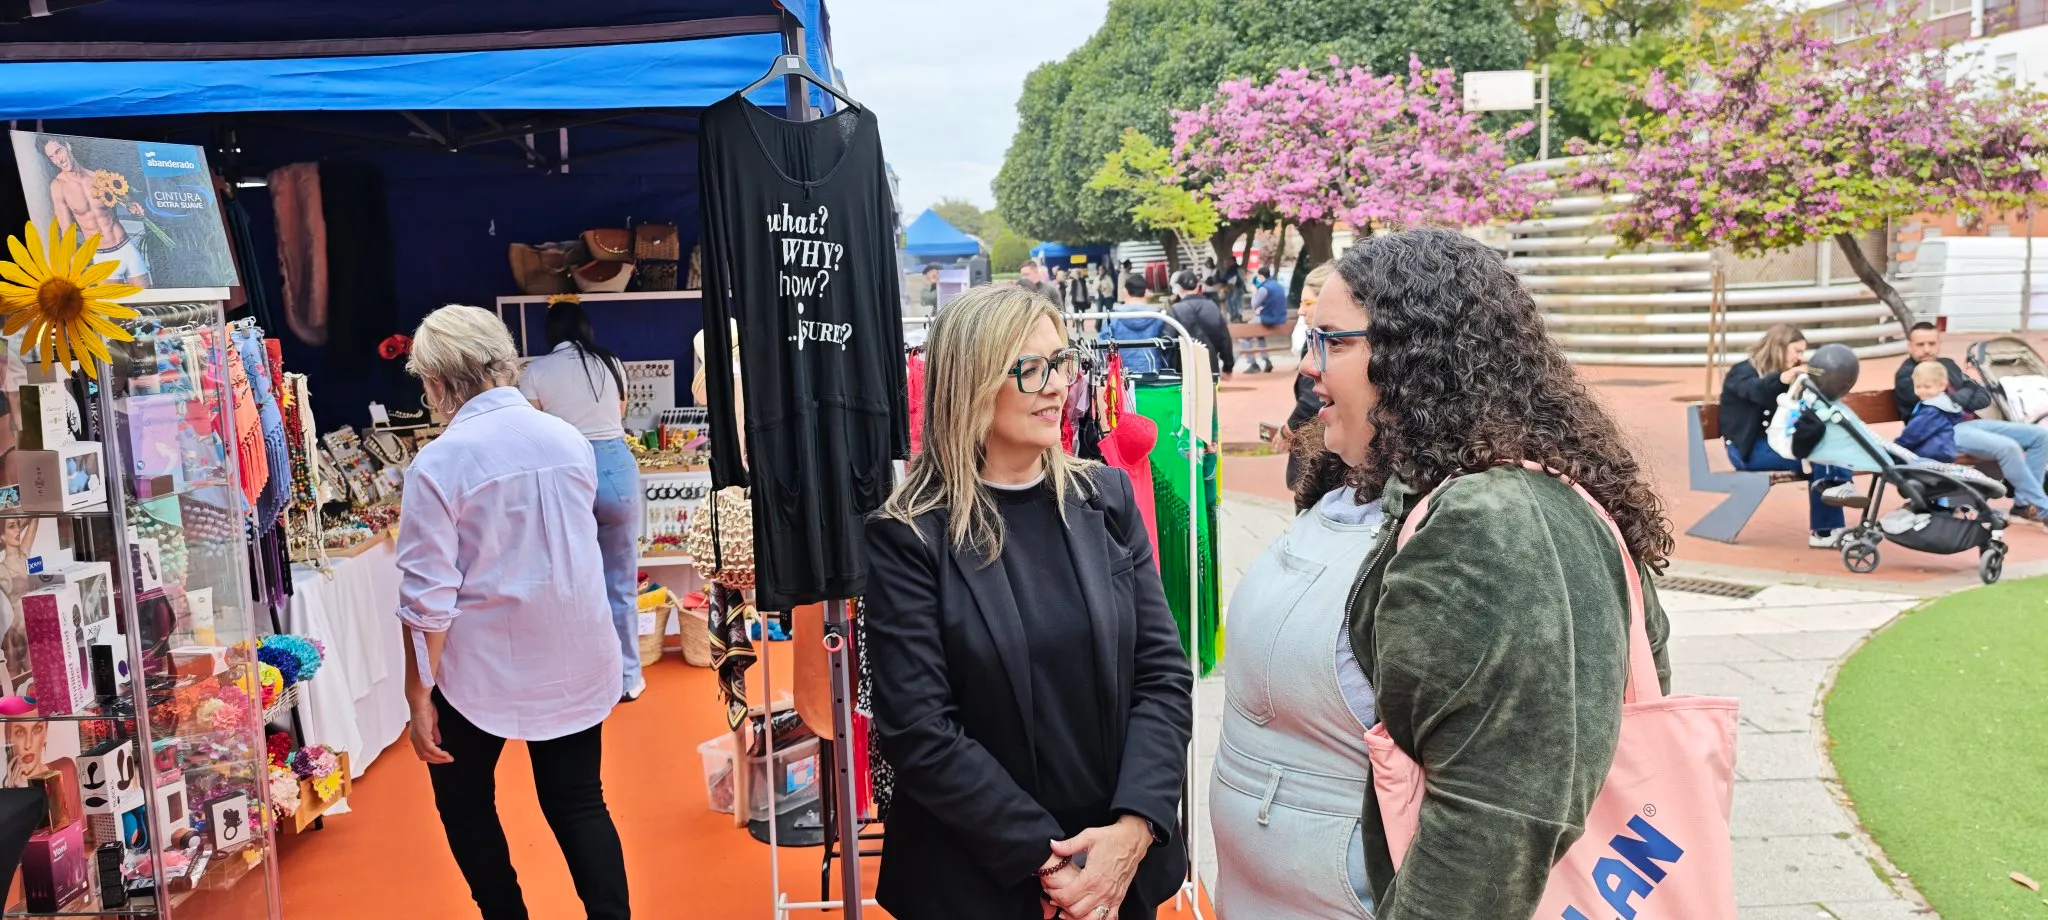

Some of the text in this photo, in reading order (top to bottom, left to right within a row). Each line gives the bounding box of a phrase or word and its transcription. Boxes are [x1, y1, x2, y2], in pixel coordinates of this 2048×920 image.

[148, 159, 194, 169] abanderado
[154, 191, 203, 202] CINTURA
[767, 203, 828, 235] what?
[781, 238, 844, 271] WHY?
[779, 270, 830, 298] how?
